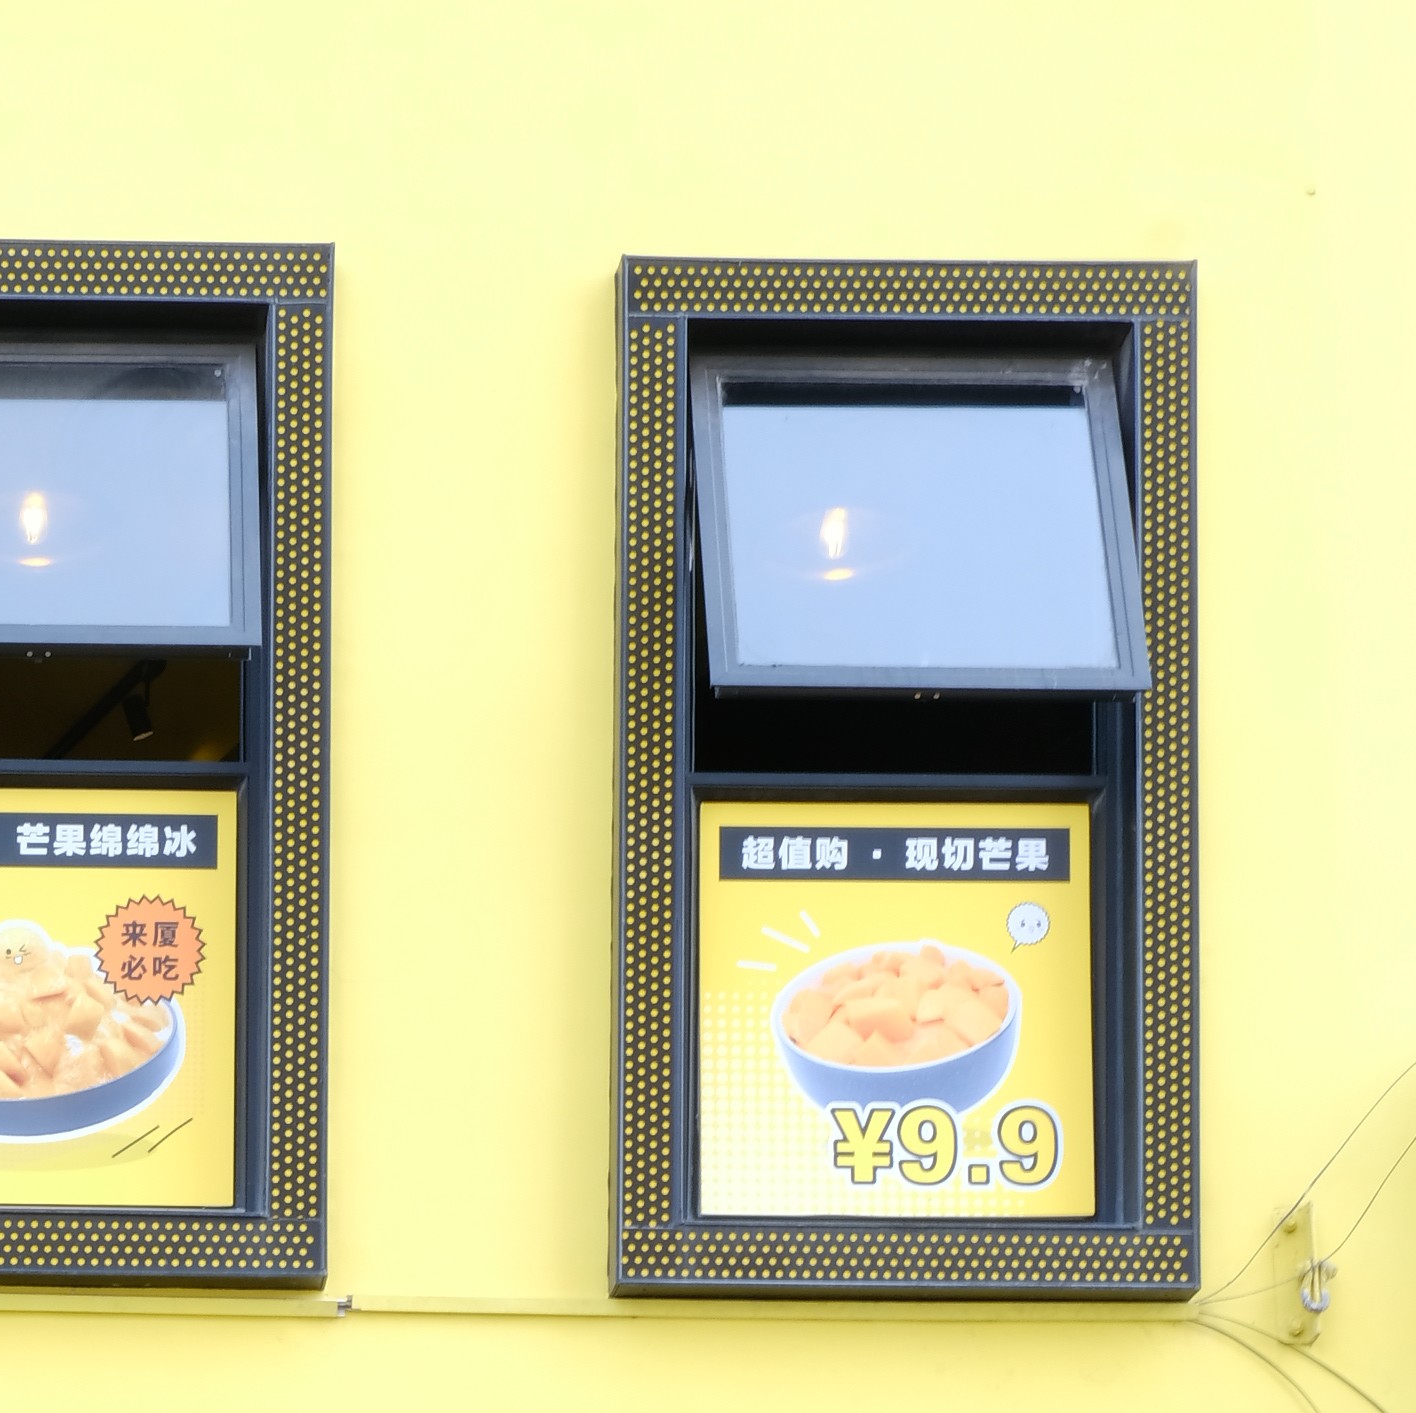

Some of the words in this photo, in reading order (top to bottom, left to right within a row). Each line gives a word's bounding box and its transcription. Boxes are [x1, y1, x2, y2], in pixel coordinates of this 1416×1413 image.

[121, 921, 180, 948] 来厦
[120, 955, 180, 981] 必吃
[831, 1105, 1059, 1185] ¥9.9
